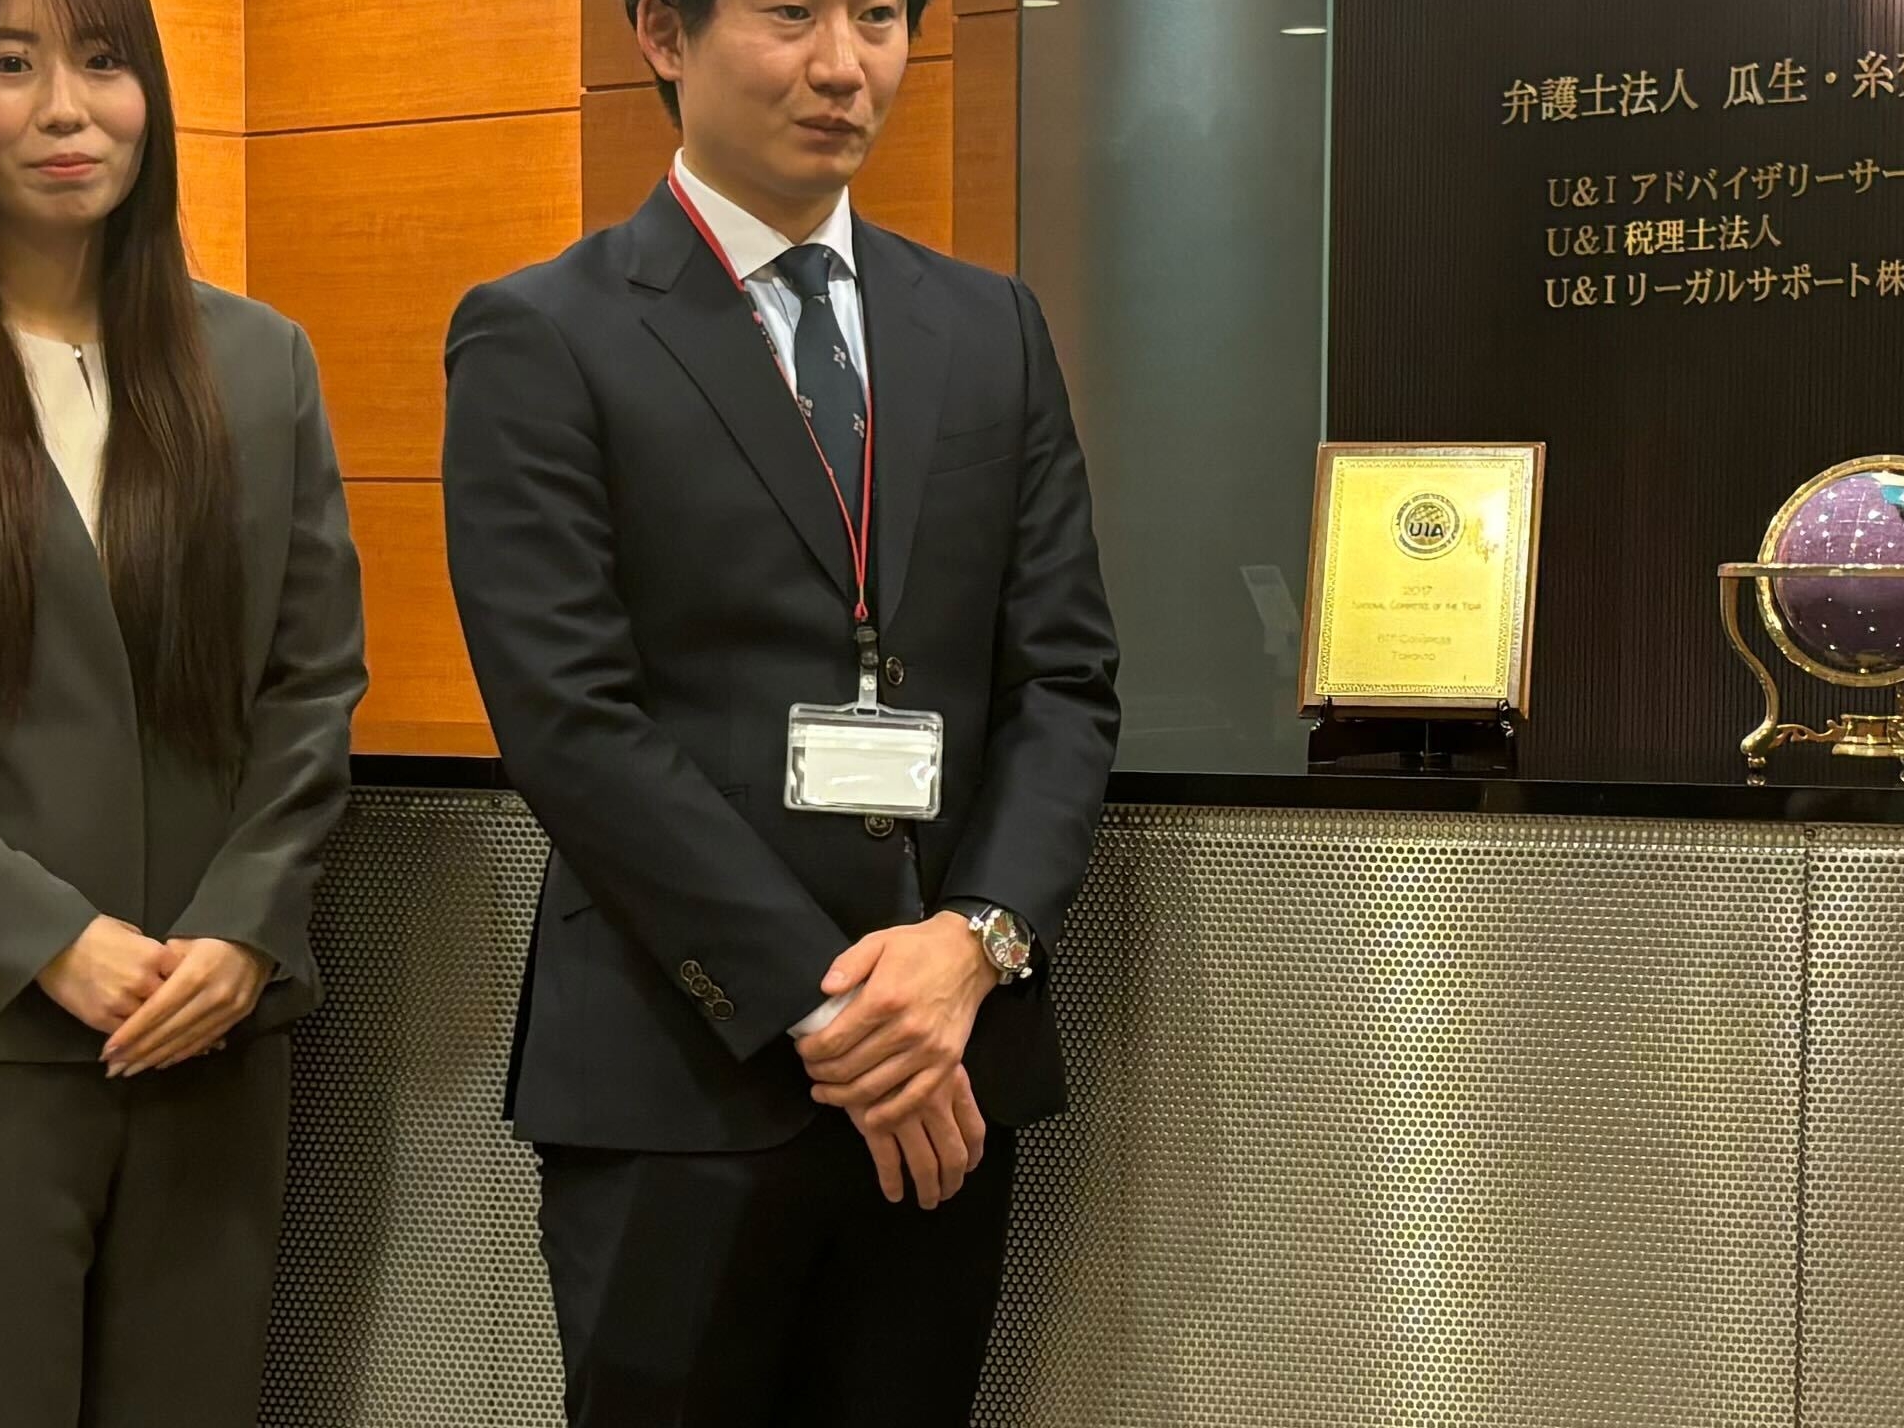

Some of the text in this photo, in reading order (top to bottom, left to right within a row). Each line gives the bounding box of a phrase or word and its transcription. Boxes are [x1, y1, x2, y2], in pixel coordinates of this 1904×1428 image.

[1501, 68, 1699, 125] 弁護士法人
[1547, 175, 1617, 208] U&I
[1409, 522, 1444, 539] UIA
